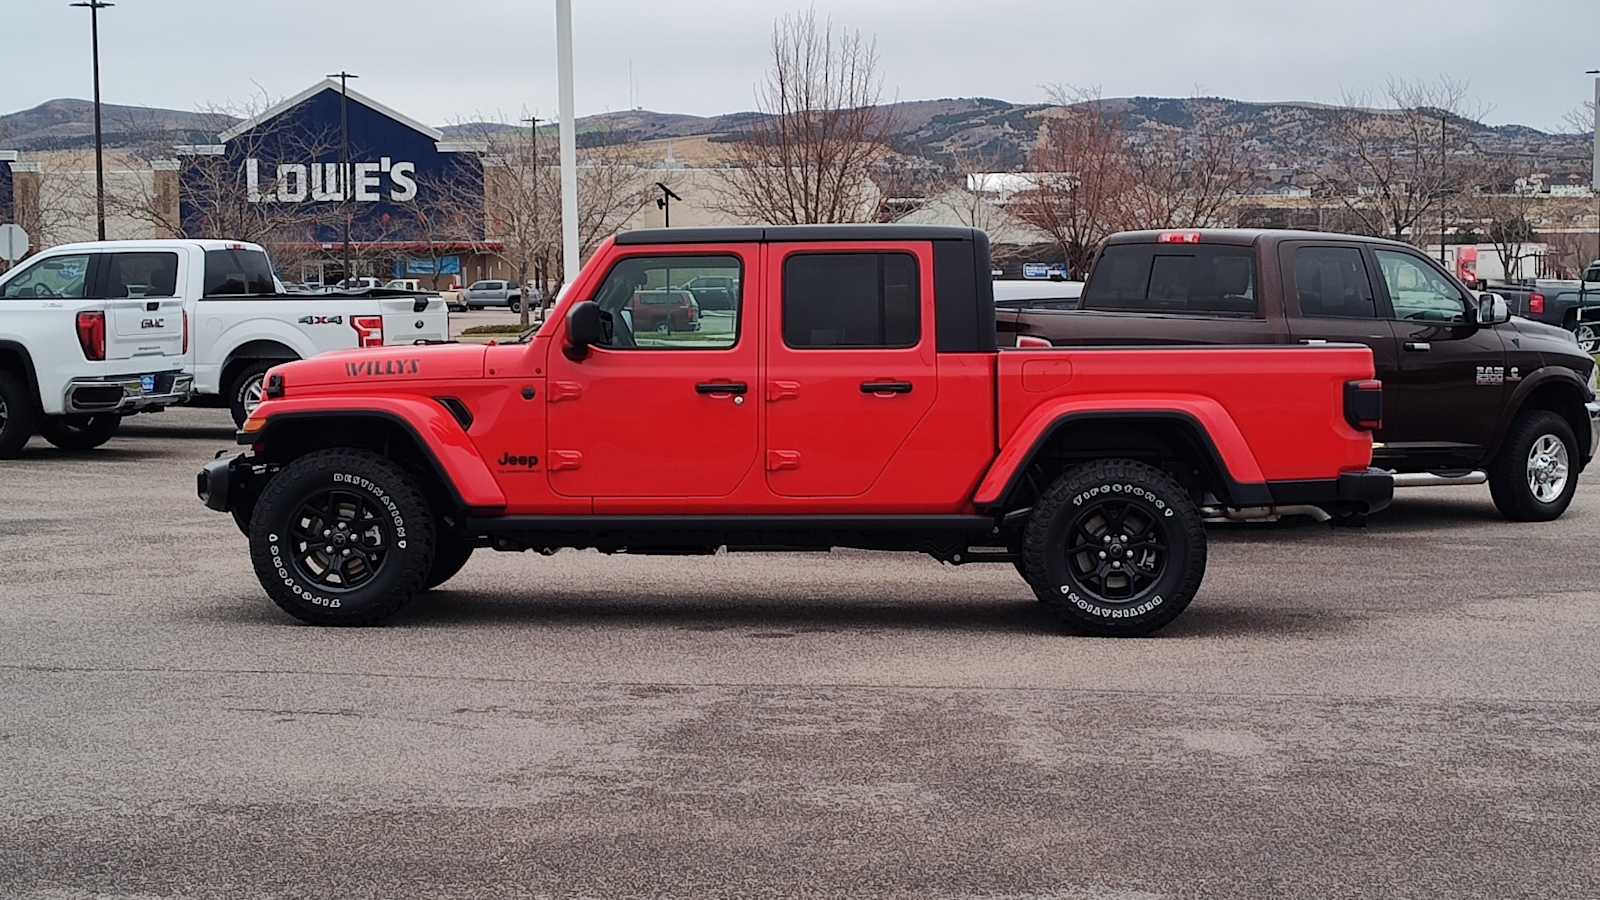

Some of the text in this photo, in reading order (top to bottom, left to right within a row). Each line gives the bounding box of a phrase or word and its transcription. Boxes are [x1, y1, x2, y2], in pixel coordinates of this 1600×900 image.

[246, 157, 418, 203] LOWE'S
[140, 318, 165, 329] GMC
[345, 359, 420, 377] WILLYS
[497, 451, 539, 468] Jeep
[333, 473, 406, 537] DESTINATION
[1067, 593, 1163, 618] DESTINATION
